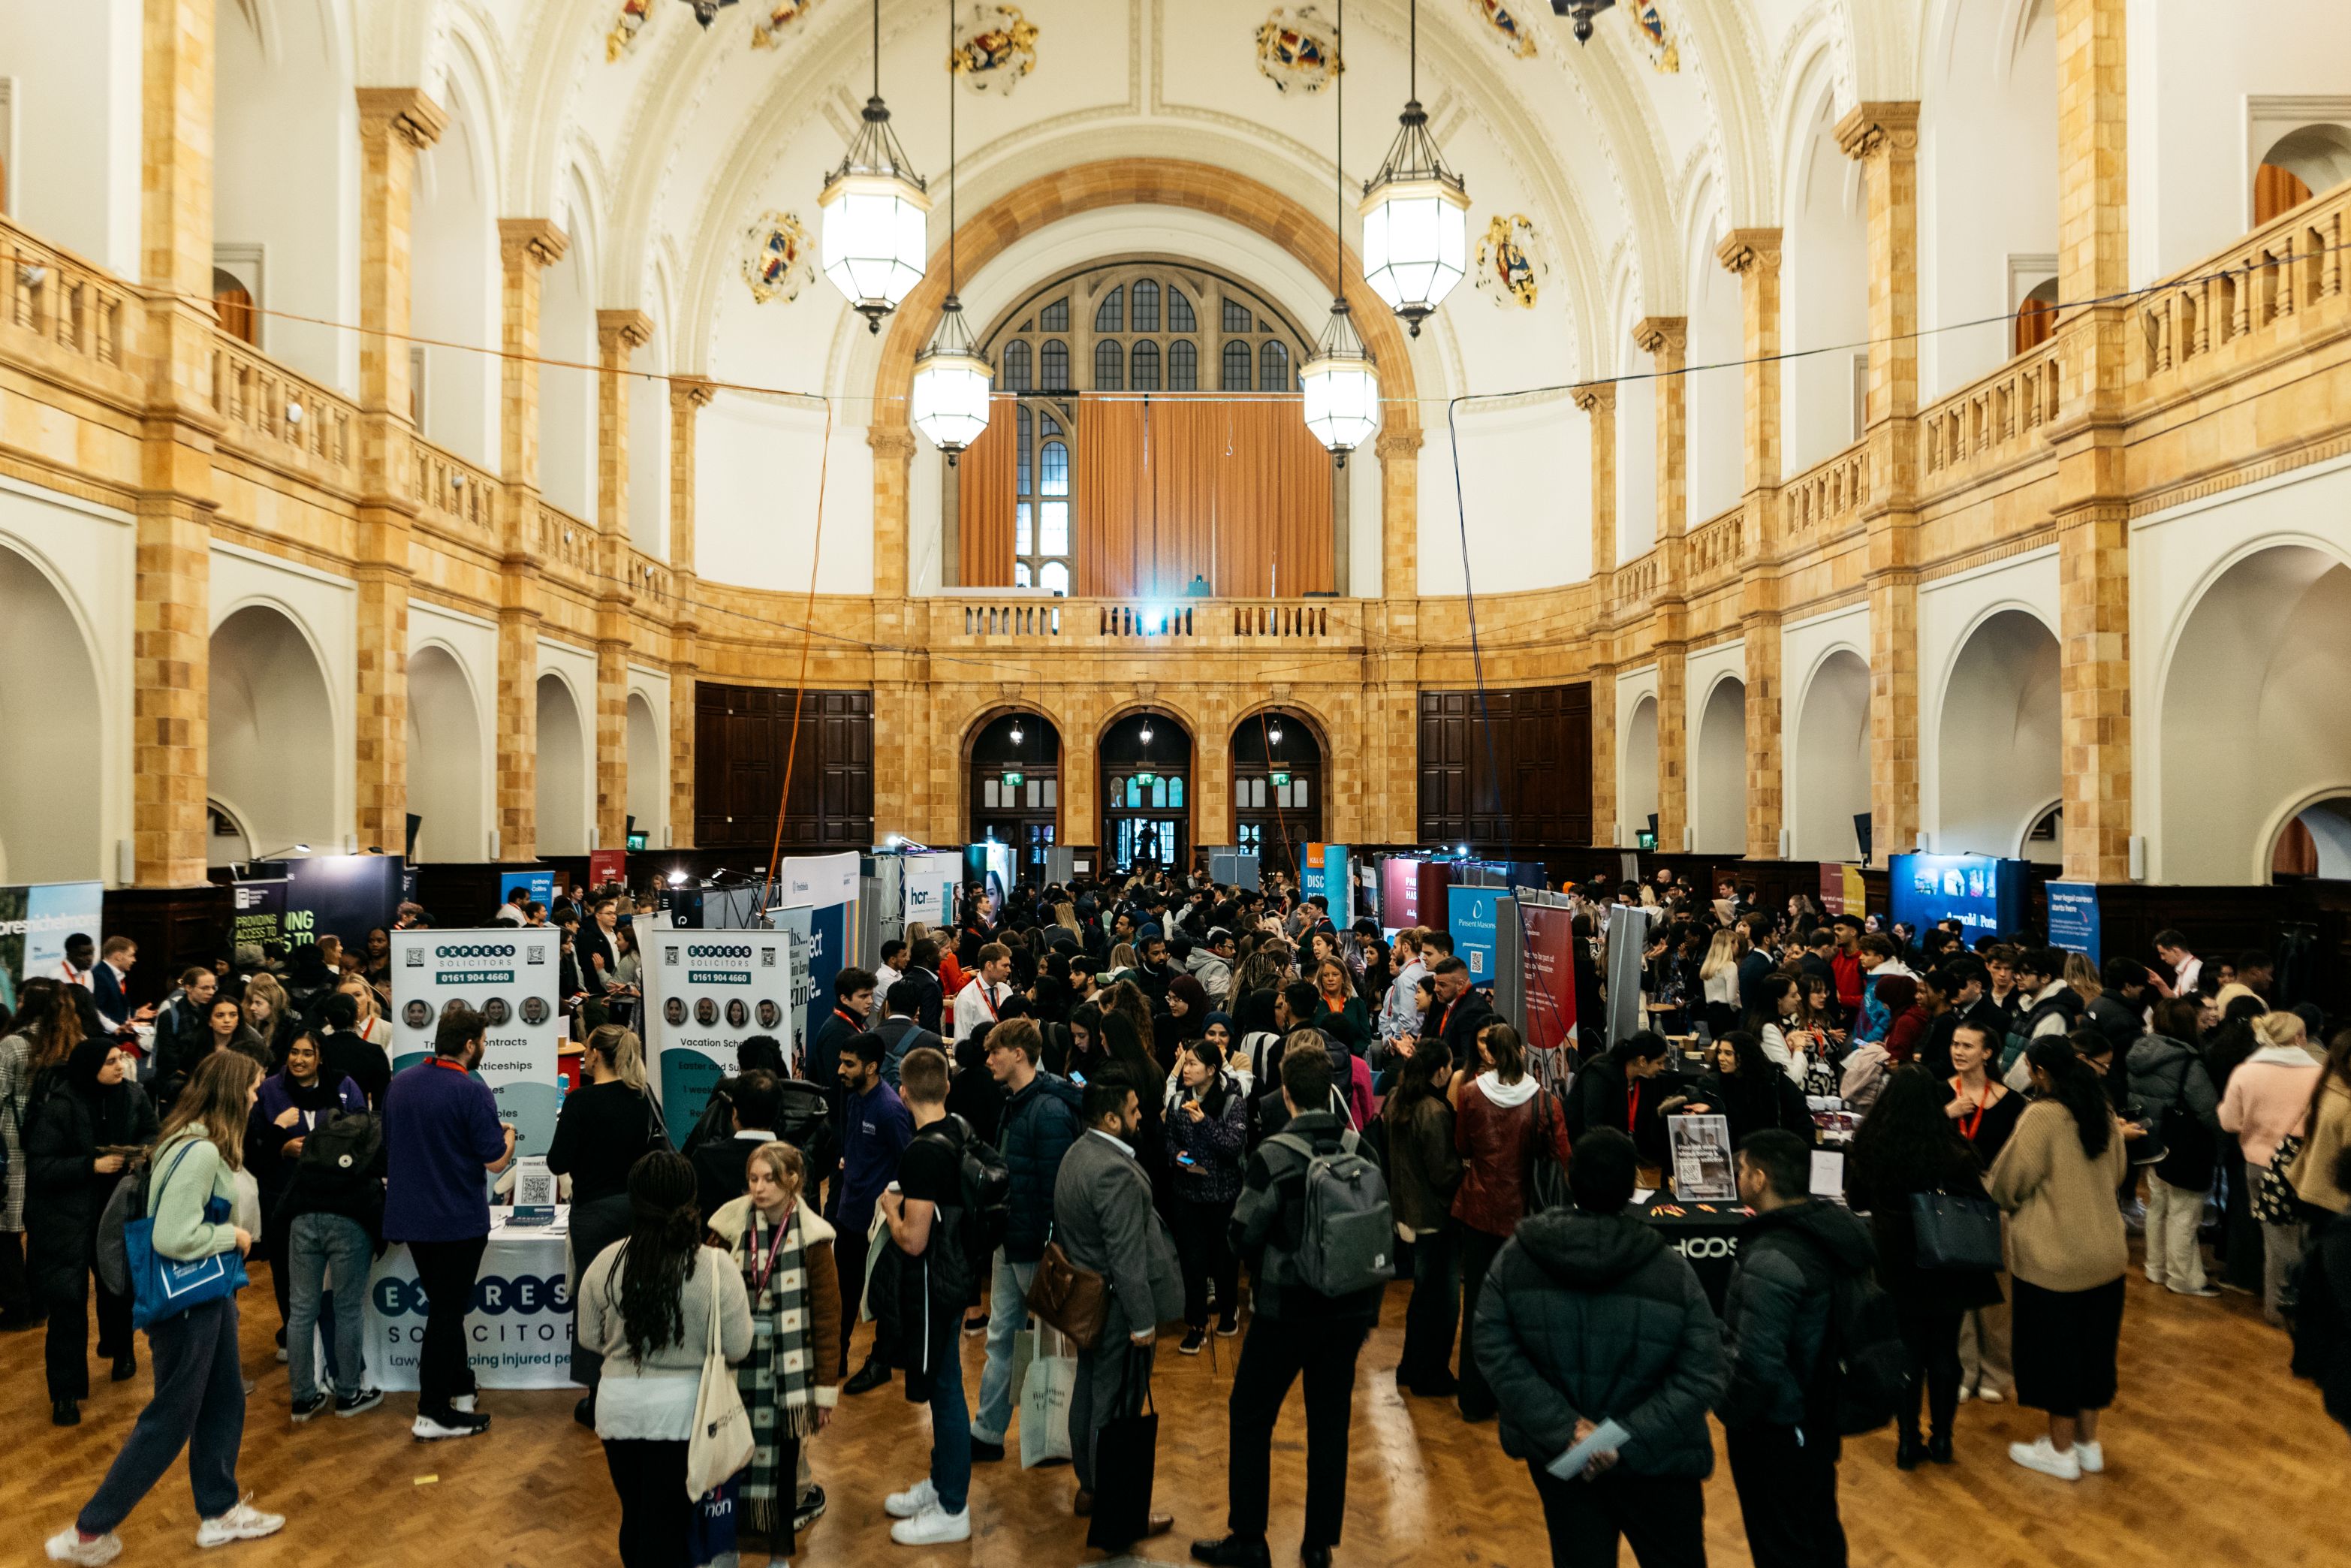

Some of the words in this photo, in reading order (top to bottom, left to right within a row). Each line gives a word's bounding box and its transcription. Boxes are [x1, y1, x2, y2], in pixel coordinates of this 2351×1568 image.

[1307, 875, 1325, 888] DISC
[1406, 876, 1416, 886] PAU
[911, 887, 928, 906] hcr
[2063, 894, 2075, 903] legal
[236, 914, 277, 927] PROVIDING
[1458, 918, 1477, 928] Pinsent
[1478, 921, 1496, 930] Masons
[1980, 915, 1997, 930] Porte
[235, 927, 266, 940] ACCESS
[266, 926, 277, 936] TO
[809, 928, 823, 959] ect
[438, 946, 514, 957] EXPRESS
[689, 947, 751, 957] EXPRESS
[440, 959, 512, 967] SOLICITORS
[442, 974, 464, 982] 0161
[467, 973, 484, 982] 904
[484, 1038, 527, 1047] ontracts
[680, 1038, 721, 1047] Vacation
[724, 1039, 743, 1048] Sche
[679, 1062, 707, 1070] Easter
[390, 1355, 420, 1369] Lawy
[467, 1353, 499, 1369] ping
[502, 1352, 551, 1368] injured
